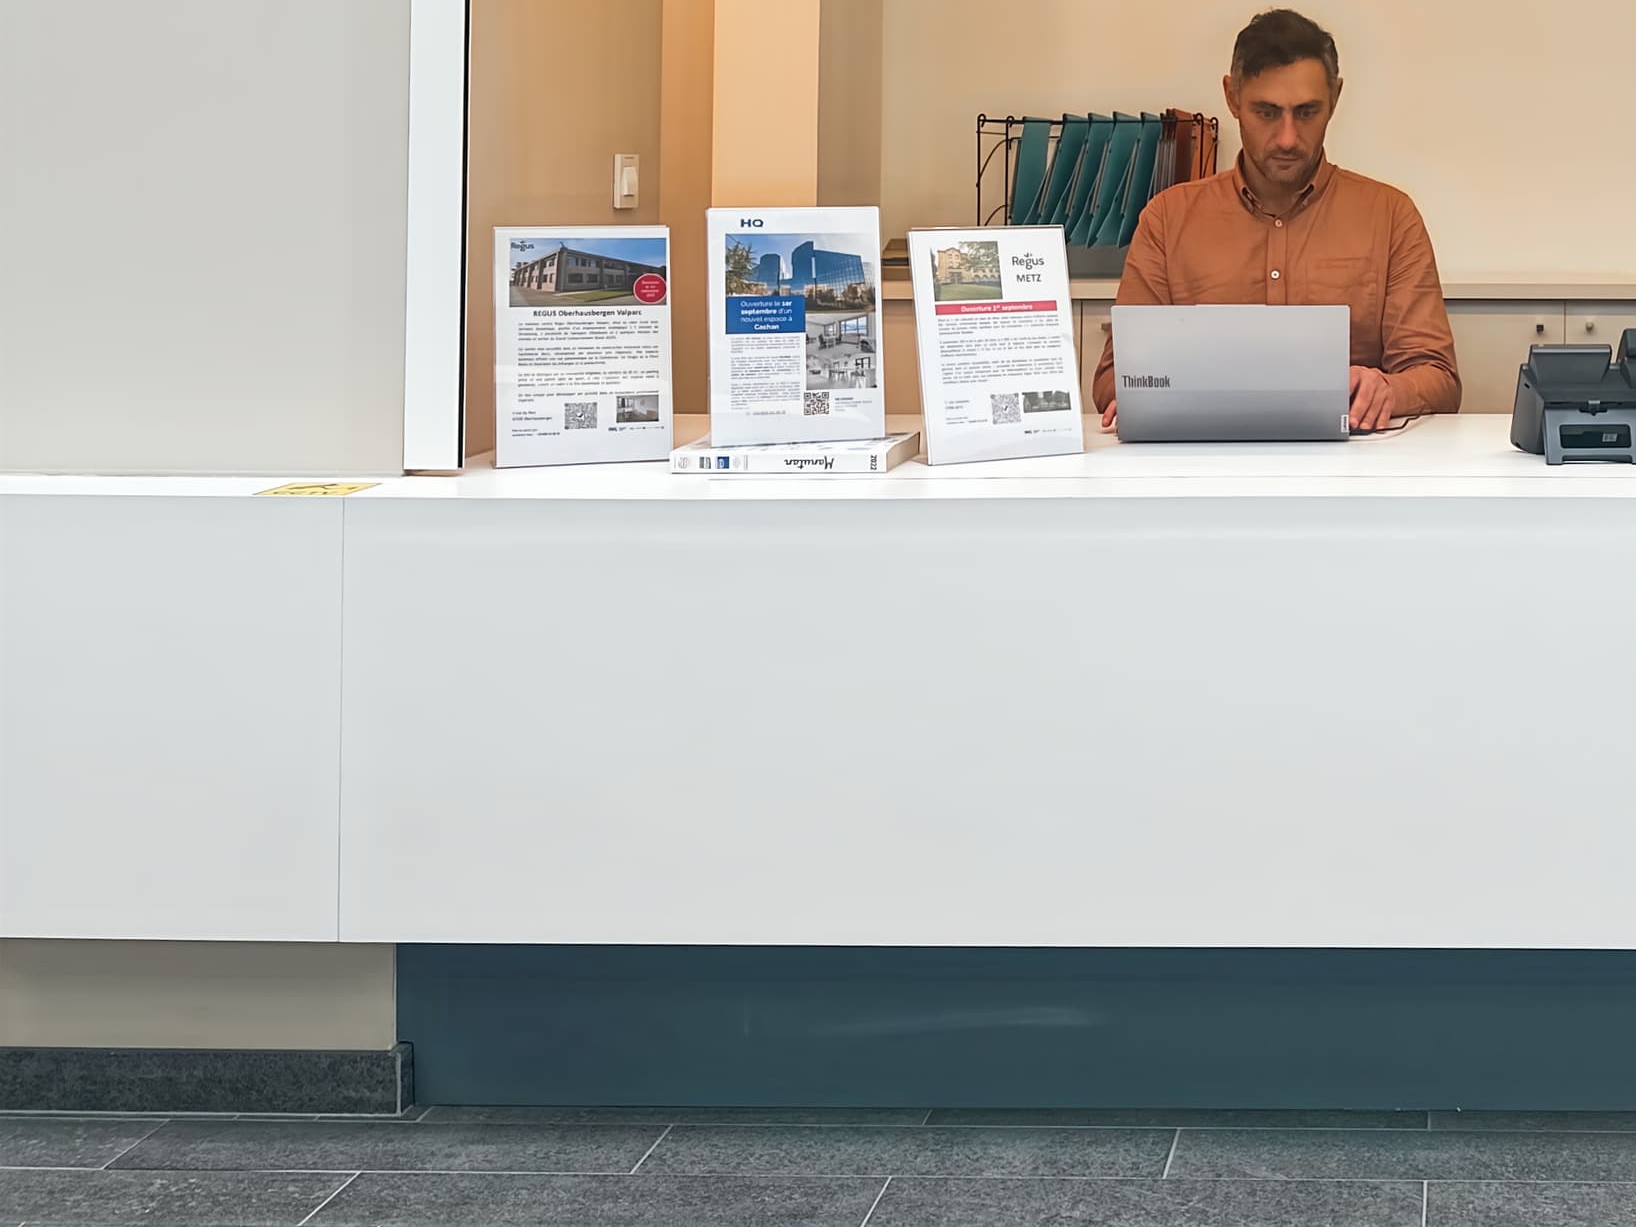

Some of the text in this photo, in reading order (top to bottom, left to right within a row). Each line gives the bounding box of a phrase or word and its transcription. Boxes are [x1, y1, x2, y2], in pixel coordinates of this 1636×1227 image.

[740, 219, 764, 227] HQ
[510, 241, 535, 251] Regus
[1011, 255, 1045, 270] Regus
[1016, 274, 1042, 283] METZ
[558, 309, 615, 318] Oberhausbergen
[617, 309, 642, 317] Valparc
[1121, 375, 1170, 389] ThinkBook
[784, 455, 834, 470] Manutan
